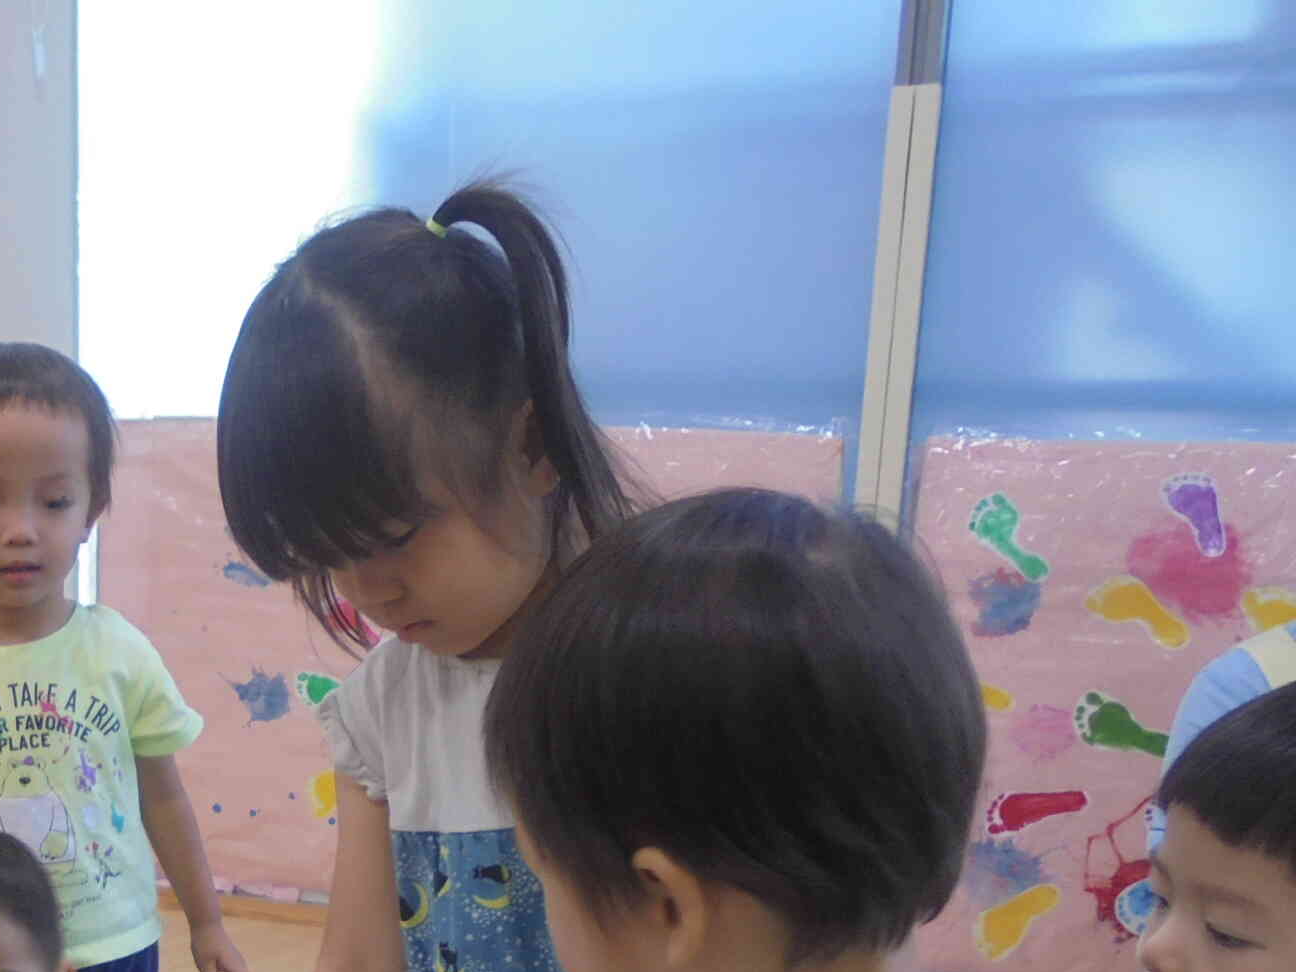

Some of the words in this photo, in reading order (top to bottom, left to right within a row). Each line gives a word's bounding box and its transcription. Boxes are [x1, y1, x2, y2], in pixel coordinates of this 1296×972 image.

[15, 714, 93, 743] FAVORITE
[65, 689, 78, 713] A
[84, 696, 120, 736] TRIP
